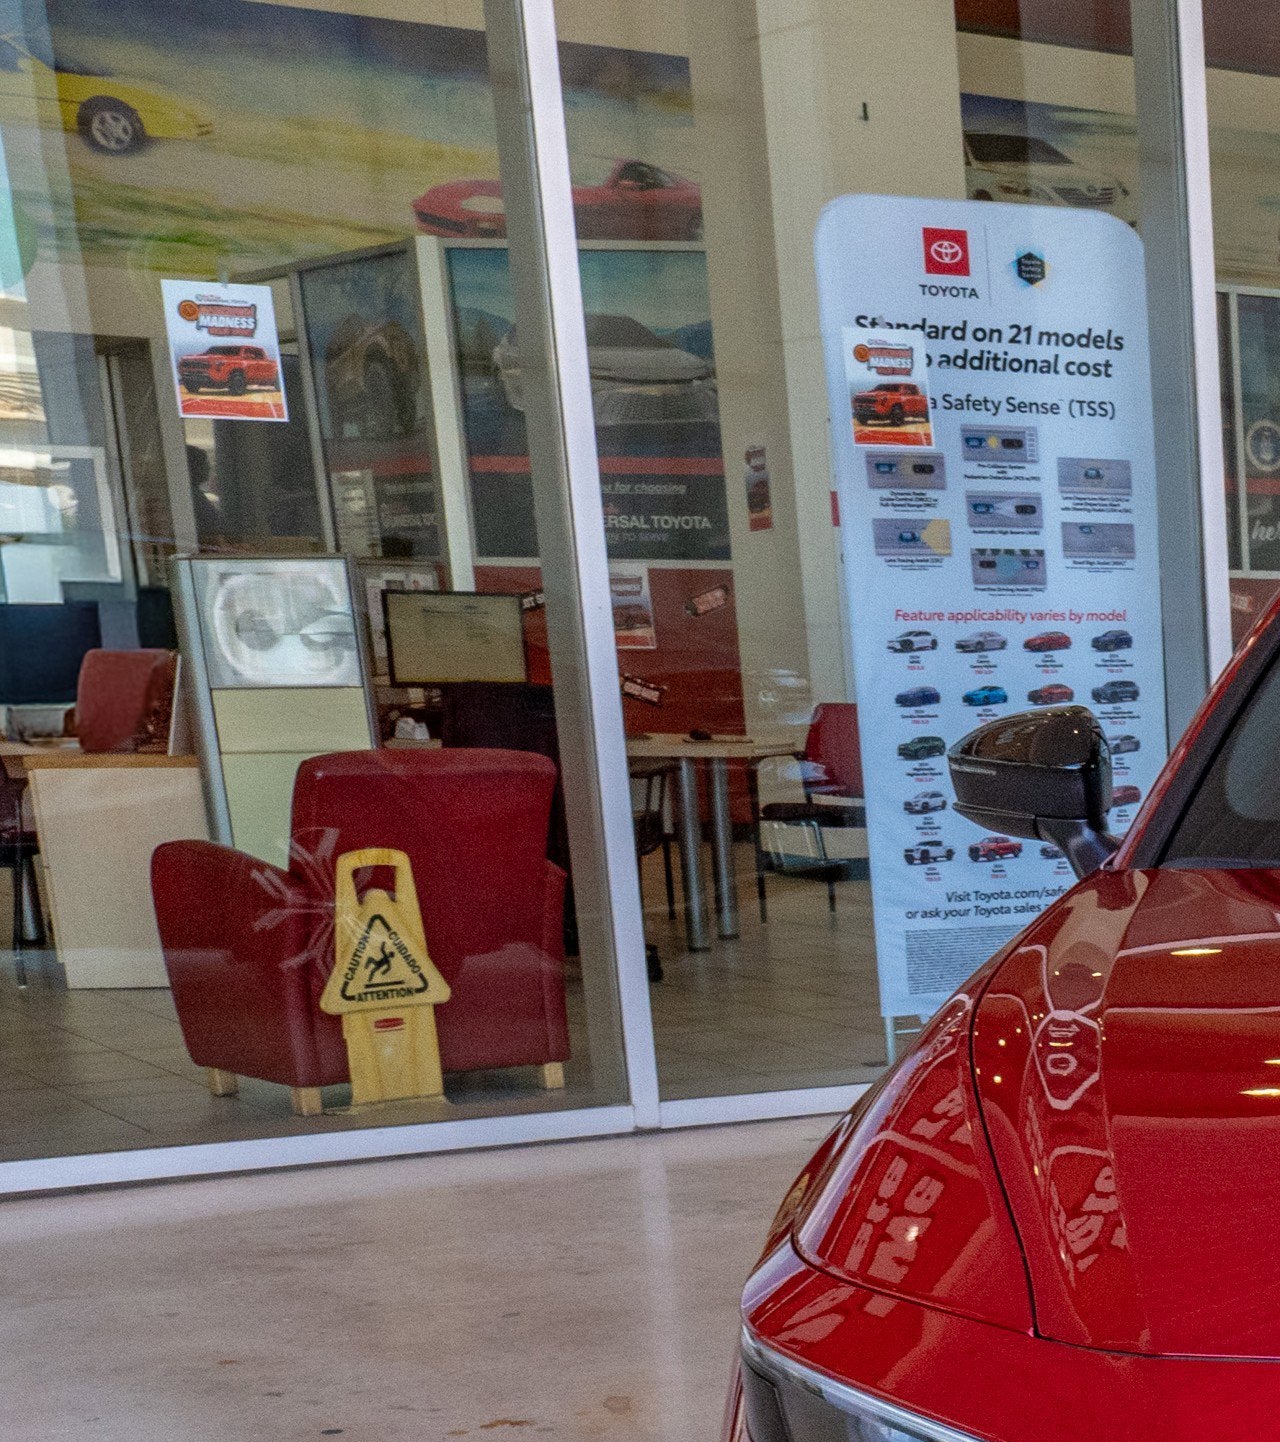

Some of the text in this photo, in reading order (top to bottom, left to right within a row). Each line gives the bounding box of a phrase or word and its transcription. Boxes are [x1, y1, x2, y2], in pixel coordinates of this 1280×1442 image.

[919, 284, 980, 299] TOYOTA
[198, 315, 256, 330] MADNESS
[973, 326, 1003, 343] on
[1008, 324, 1032, 345] 21
[1037, 327, 1124, 351] models
[938, 349, 1060, 375] additional
[1065, 358, 1113, 378] cost
[943, 394, 1001, 417] Safety
[1068, 399, 1117, 420] (TSS)
[651, 515, 713, 530] TOYOTA
[894, 609, 1127, 625] Feature applicability varies by model
[946, 890, 971, 903] Visit
[905, 902, 1042, 921] or ask your Toyota sales
[344, 930, 371, 982] CAUTION
[388, 931, 422, 974] CUIDADO
[356, 987, 415, 1002] ATTENTION
